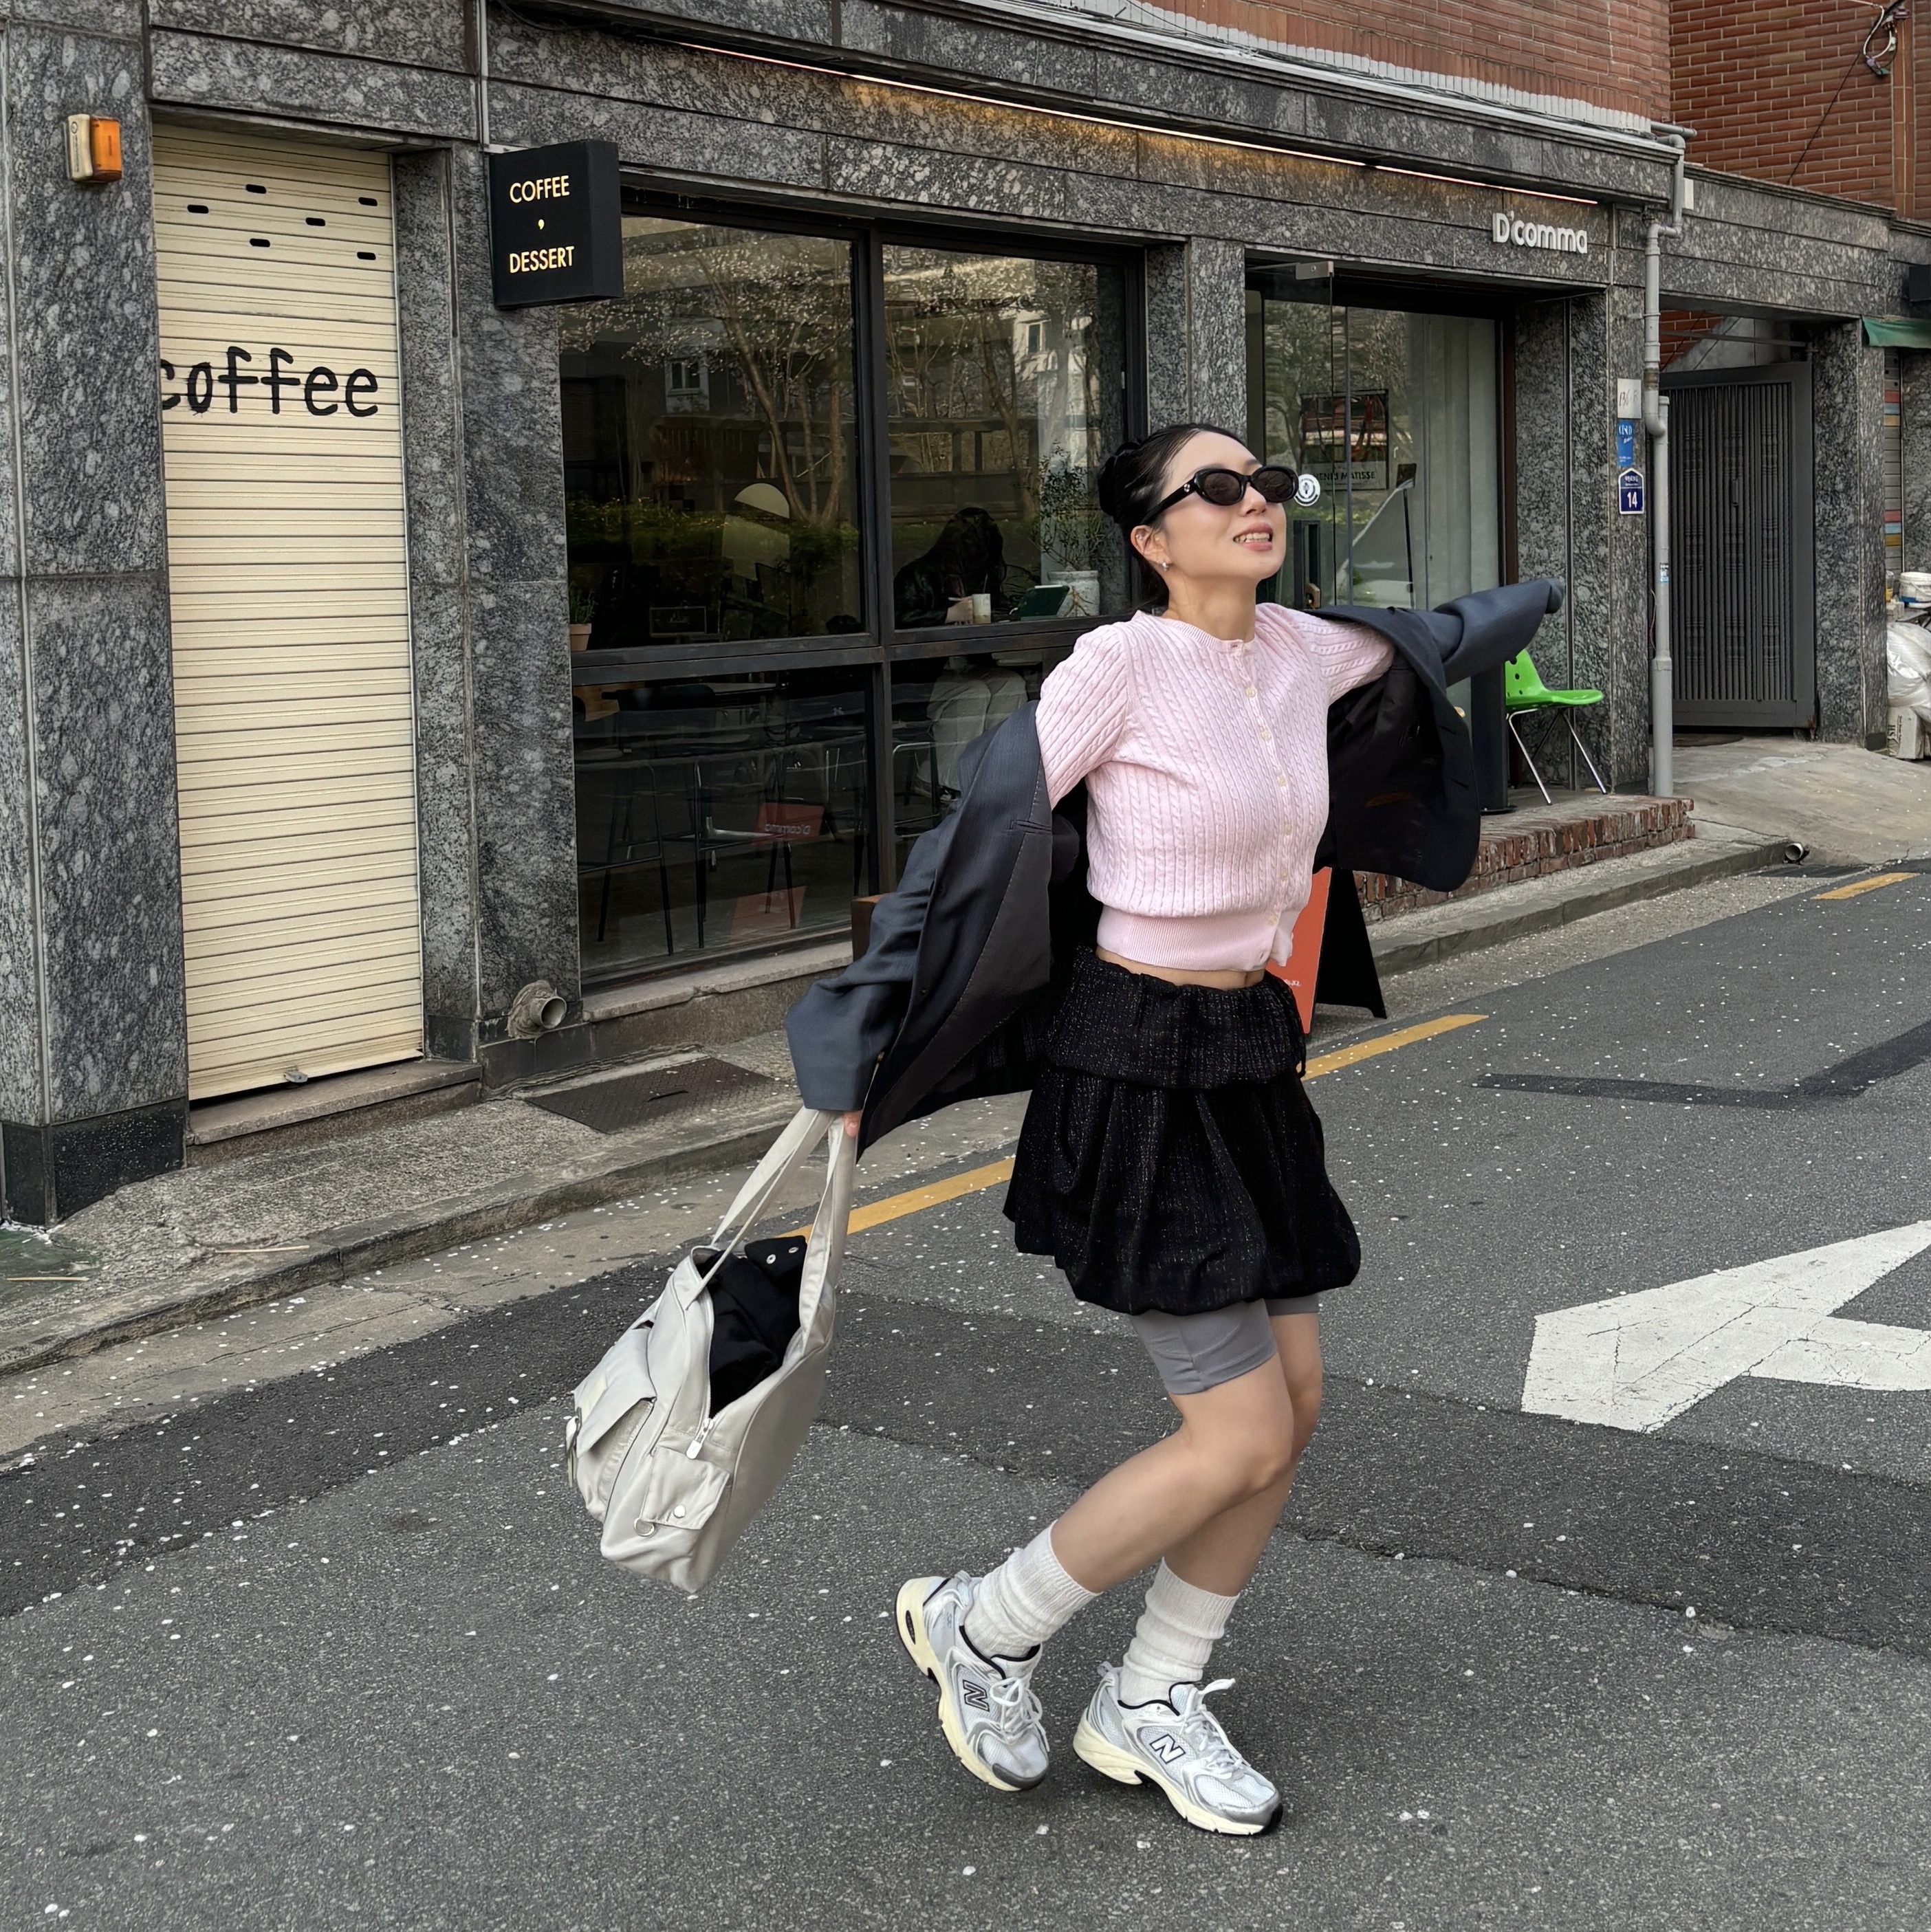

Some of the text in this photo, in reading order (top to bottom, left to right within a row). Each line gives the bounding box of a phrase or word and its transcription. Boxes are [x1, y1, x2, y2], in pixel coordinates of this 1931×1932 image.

[509, 175, 570, 204] COFFEE
[1492, 210, 1588, 254] D'comma
[509, 245, 575, 274] DESSERT
[160, 345, 378, 417] coffee
[1626, 491, 1638, 509] 14
[1149, 1733, 1186, 1765] N
